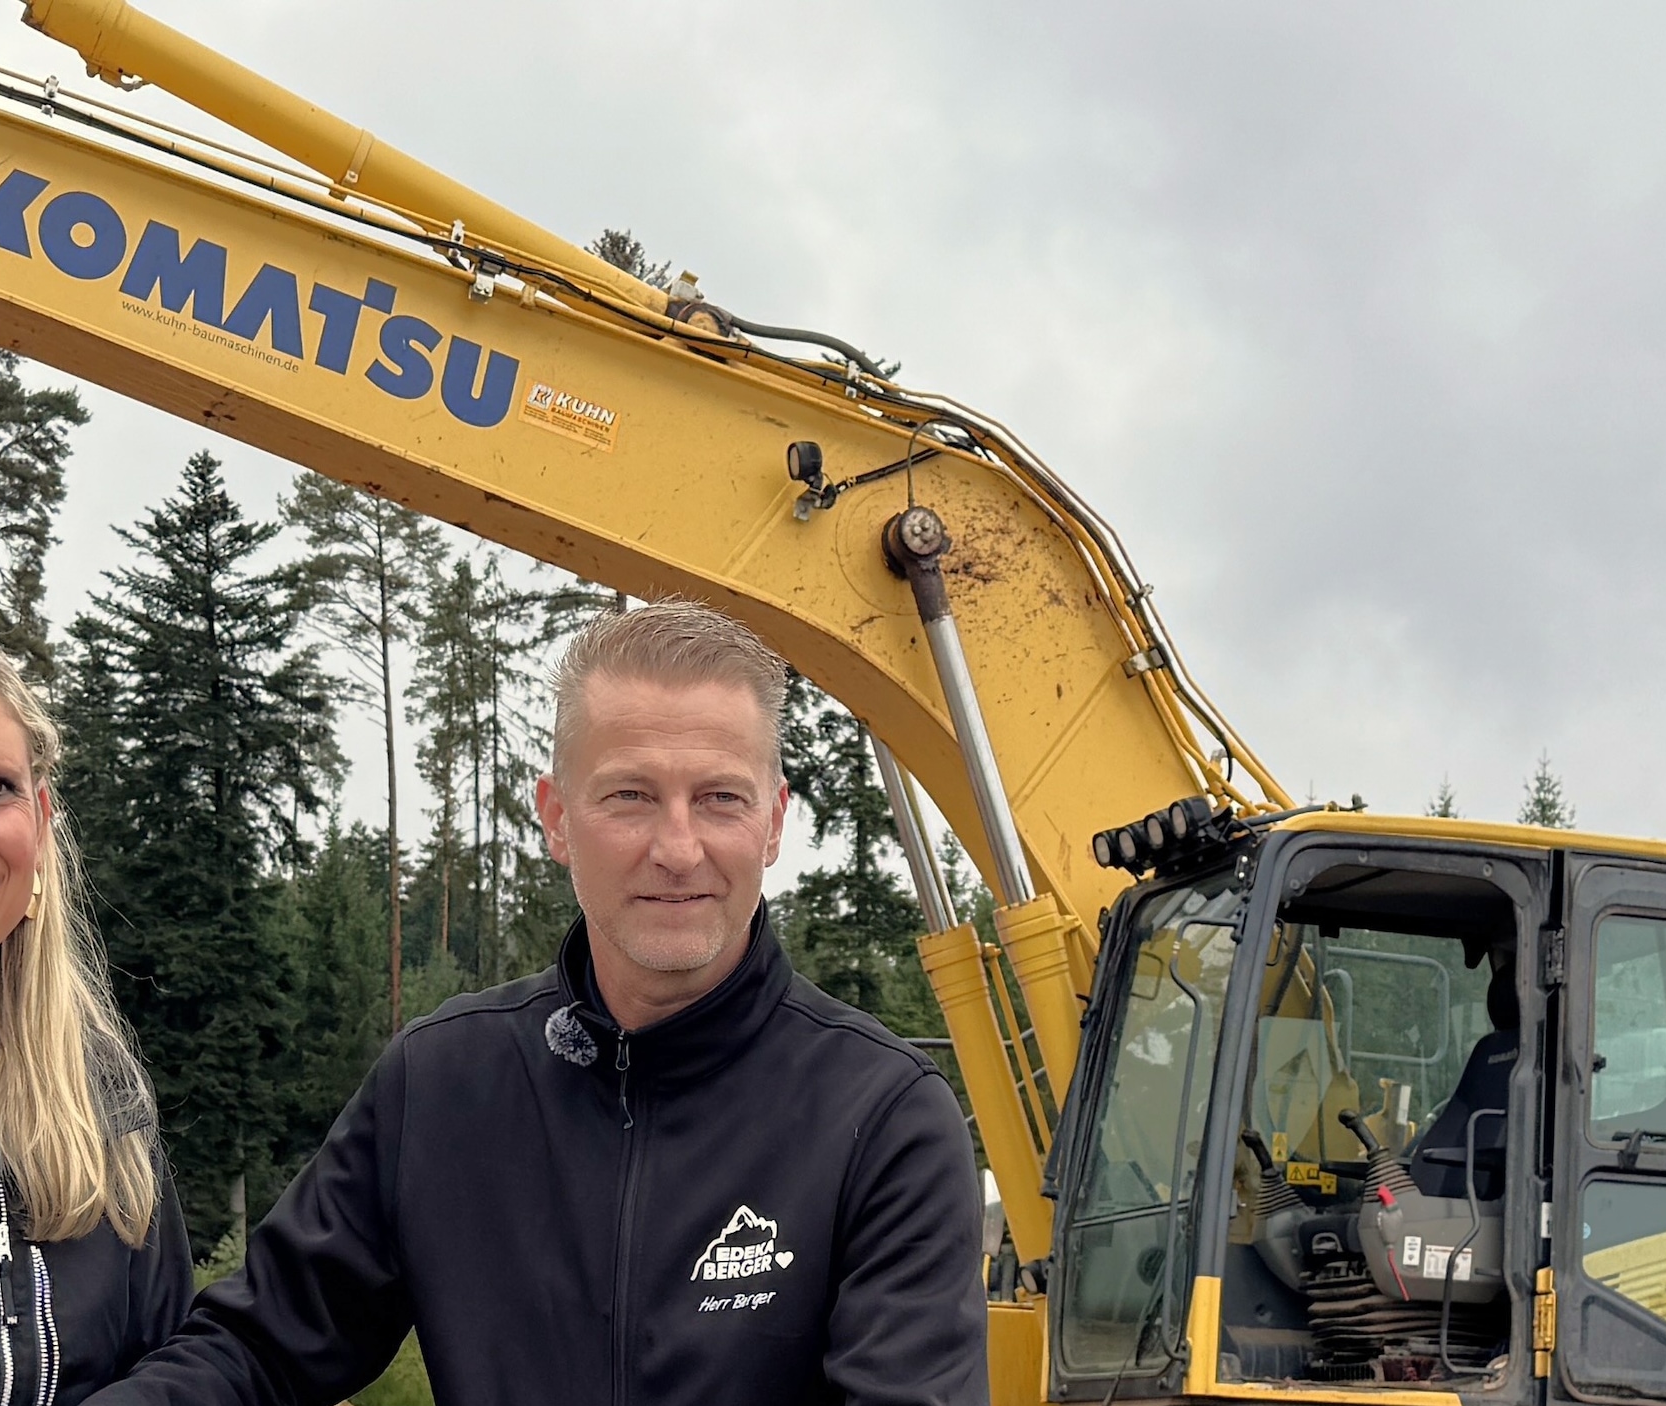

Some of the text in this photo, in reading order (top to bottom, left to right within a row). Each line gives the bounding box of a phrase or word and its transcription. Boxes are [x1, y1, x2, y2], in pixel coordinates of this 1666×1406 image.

[121, 300, 300, 374] www.kuhn-baumaschinen.de
[555, 392, 617, 426] KUHN
[716, 1239, 774, 1261] EDEKA
[703, 1254, 772, 1280] BERGER
[698, 1296, 732, 1312] Herr
[732, 1292, 777, 1310] Berger
